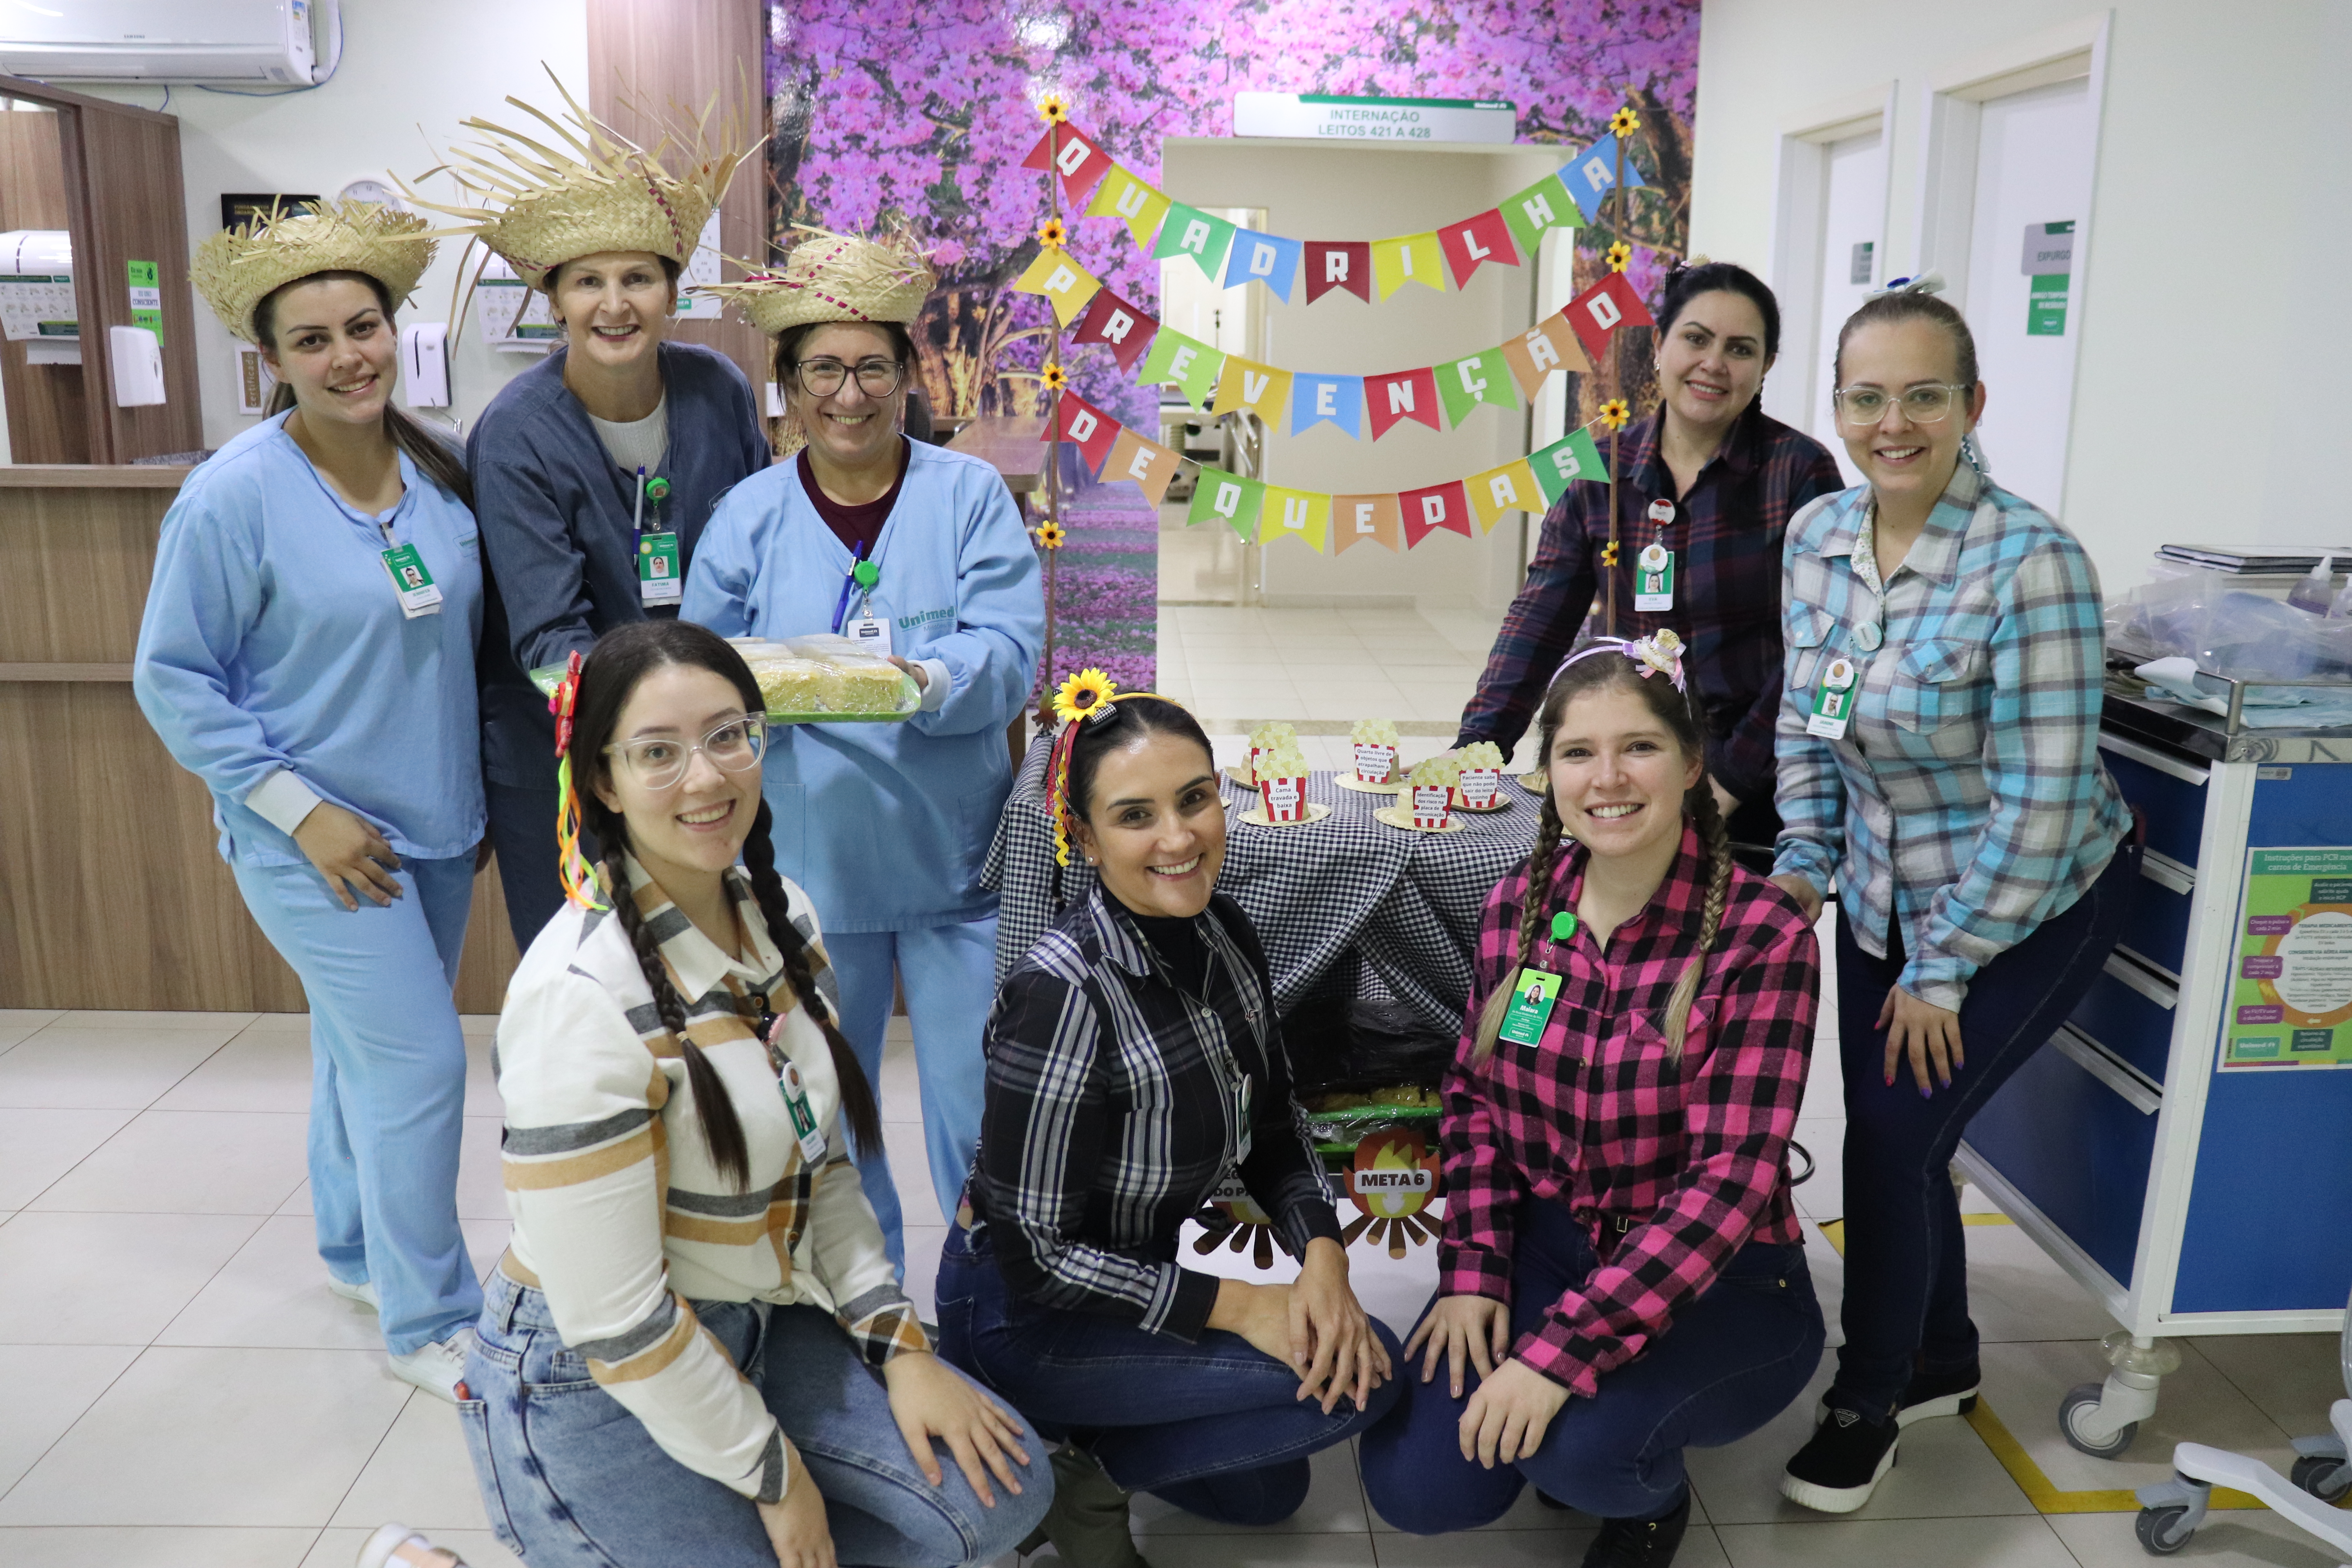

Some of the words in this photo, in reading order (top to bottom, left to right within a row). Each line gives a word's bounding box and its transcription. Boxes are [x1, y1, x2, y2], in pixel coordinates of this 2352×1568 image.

[1330, 109, 1419, 123] INTERNAÇÃO
[1319, 124, 1366, 136] LEITOS
[1370, 126, 1391, 136] 421
[1396, 127, 1406, 137] A
[1408, 127, 1431, 138] 428
[1056, 137, 1614, 282] QUADRILHA
[1043, 264, 1621, 415] PREVENÇÃO
[245, 353, 257, 407] certificado
[1068, 409, 1156, 481] DE
[1214, 446, 1581, 534] QUEDAS
[898, 606, 955, 629] Unimed
[2264, 854, 2303, 862] Instruções
[2303, 863, 2347, 872] Emergência
[1519, 1005, 1538, 1014] Maiara
[1361, 1174, 1411, 1186] META
[1414, 1173, 1425, 1185] 6
